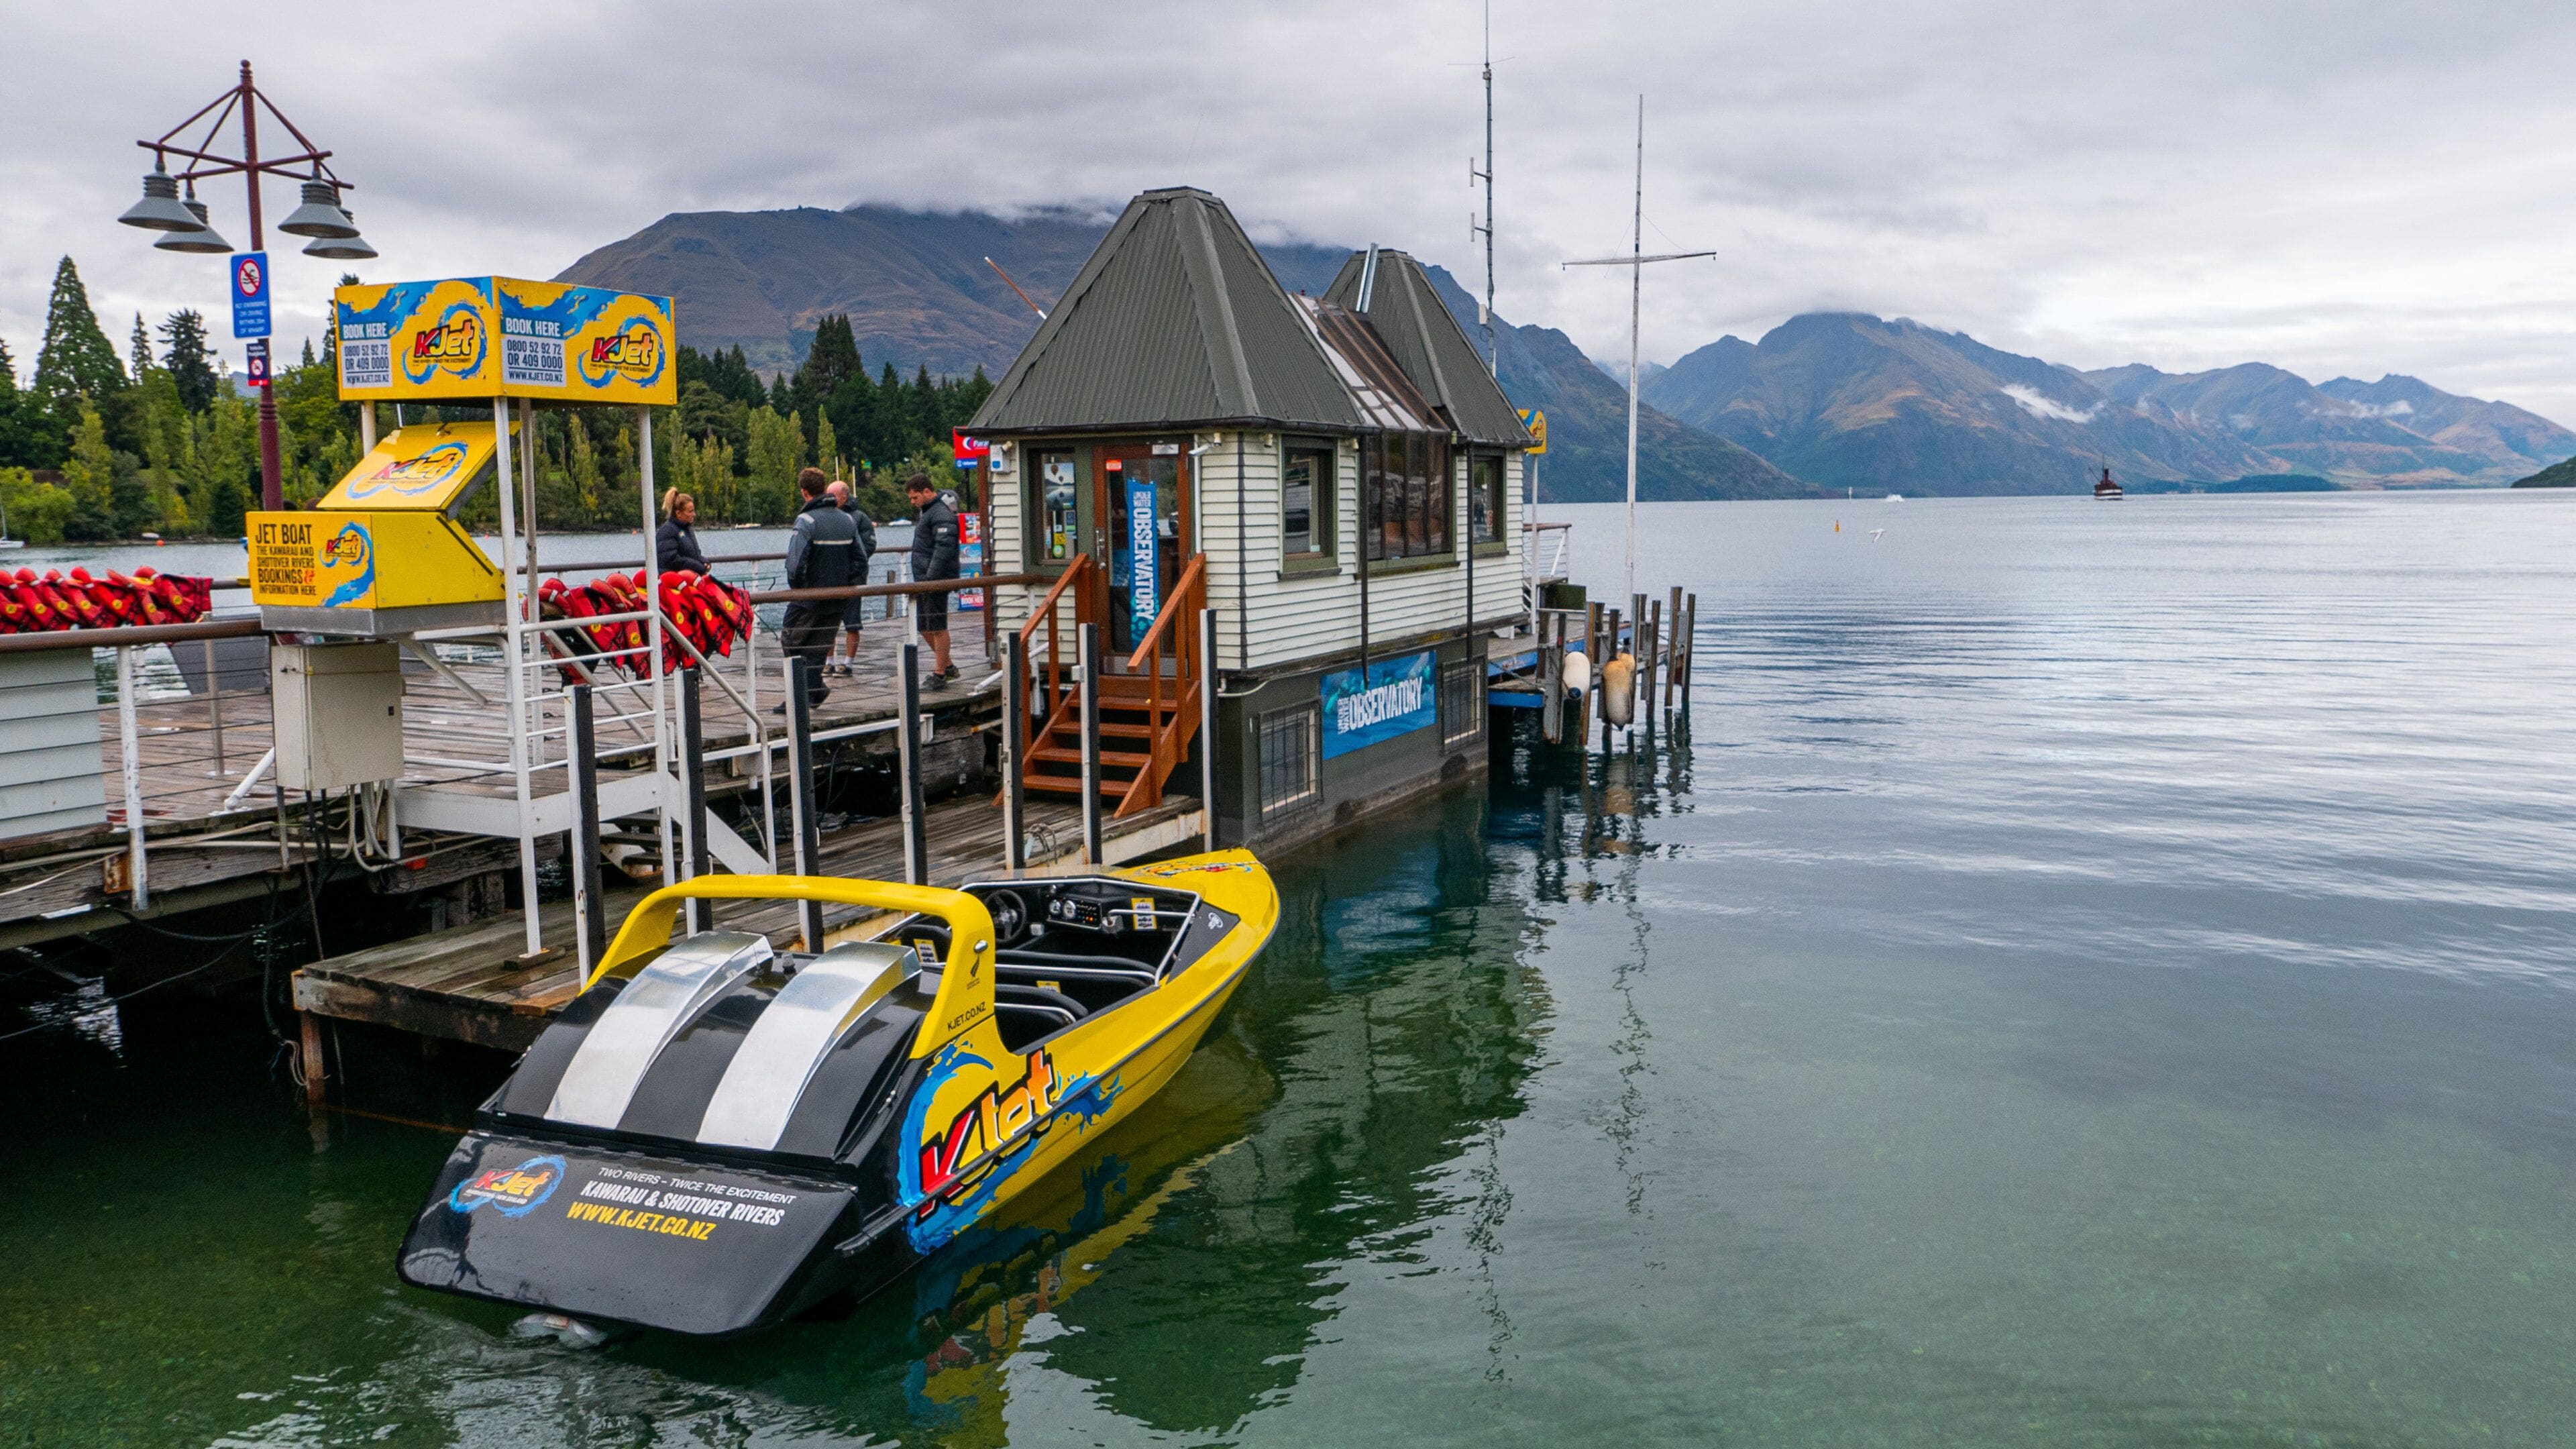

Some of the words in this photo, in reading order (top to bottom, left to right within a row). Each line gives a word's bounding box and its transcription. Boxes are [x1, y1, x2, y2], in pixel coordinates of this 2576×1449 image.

[343, 324, 365, 338] BOOK
[366, 323, 387, 337] HERE
[506, 317, 533, 334] BOOK
[535, 321, 561, 337] HERE
[414, 319, 474, 358] KJet
[507, 339, 527, 352] 0800
[529, 341, 539, 354] 52
[541, 343, 550, 354] 92
[553, 343, 561, 355] 72
[345, 345, 360, 356] 0800
[362, 345, 369, 356] 52
[371, 344, 378, 356] 92
[380, 343, 388, 355] 72
[592, 333, 653, 366] KJet
[345, 358, 354, 370] OR
[356, 358, 369, 369] 409
[372, 357, 388, 368] 0000
[508, 353, 520, 366] OR
[523, 354, 539, 367] 409
[541, 356, 563, 368] 0000
[508, 370, 563, 382] WWW.KJET.CO.NZ
[256, 523, 276, 544] JET
[281, 524, 312, 544] BOAT
[256, 545, 268, 555] THE
[270, 546, 299, 555] KAWARAU
[301, 547, 314, 556] AND
[257, 557, 289, 568] SHOTOVER
[292, 557, 315, 568] RIVERS
[1133, 508, 1155, 621] OBSERVATORY
[258, 568, 303, 584] BOOKINGS
[304, 570, 315, 584] &
[259, 584, 299, 595] INFORMATION
[301, 585, 316, 596] HERE
[1349, 676, 1422, 731] OBSERVATORY
[947, 1001, 986, 1032] KJET.CO.NZ
[473, 1169, 551, 1197] KJet
[598, 1167, 623, 1179] TWO
[625, 1171, 662, 1185] RIVERS
[669, 1178, 703, 1192] TWICE
[704, 1183, 726, 1195] THE
[726, 1187, 796, 1205] EXCITEMENT
[580, 1180, 649, 1205] KAWARAU
[644, 1191, 660, 1208] &
[658, 1192, 733, 1219] SHOTOVER
[729, 1203, 786, 1226] RIVERS
[567, 1201, 716, 1240] WWW.KJET.CO.NZ
